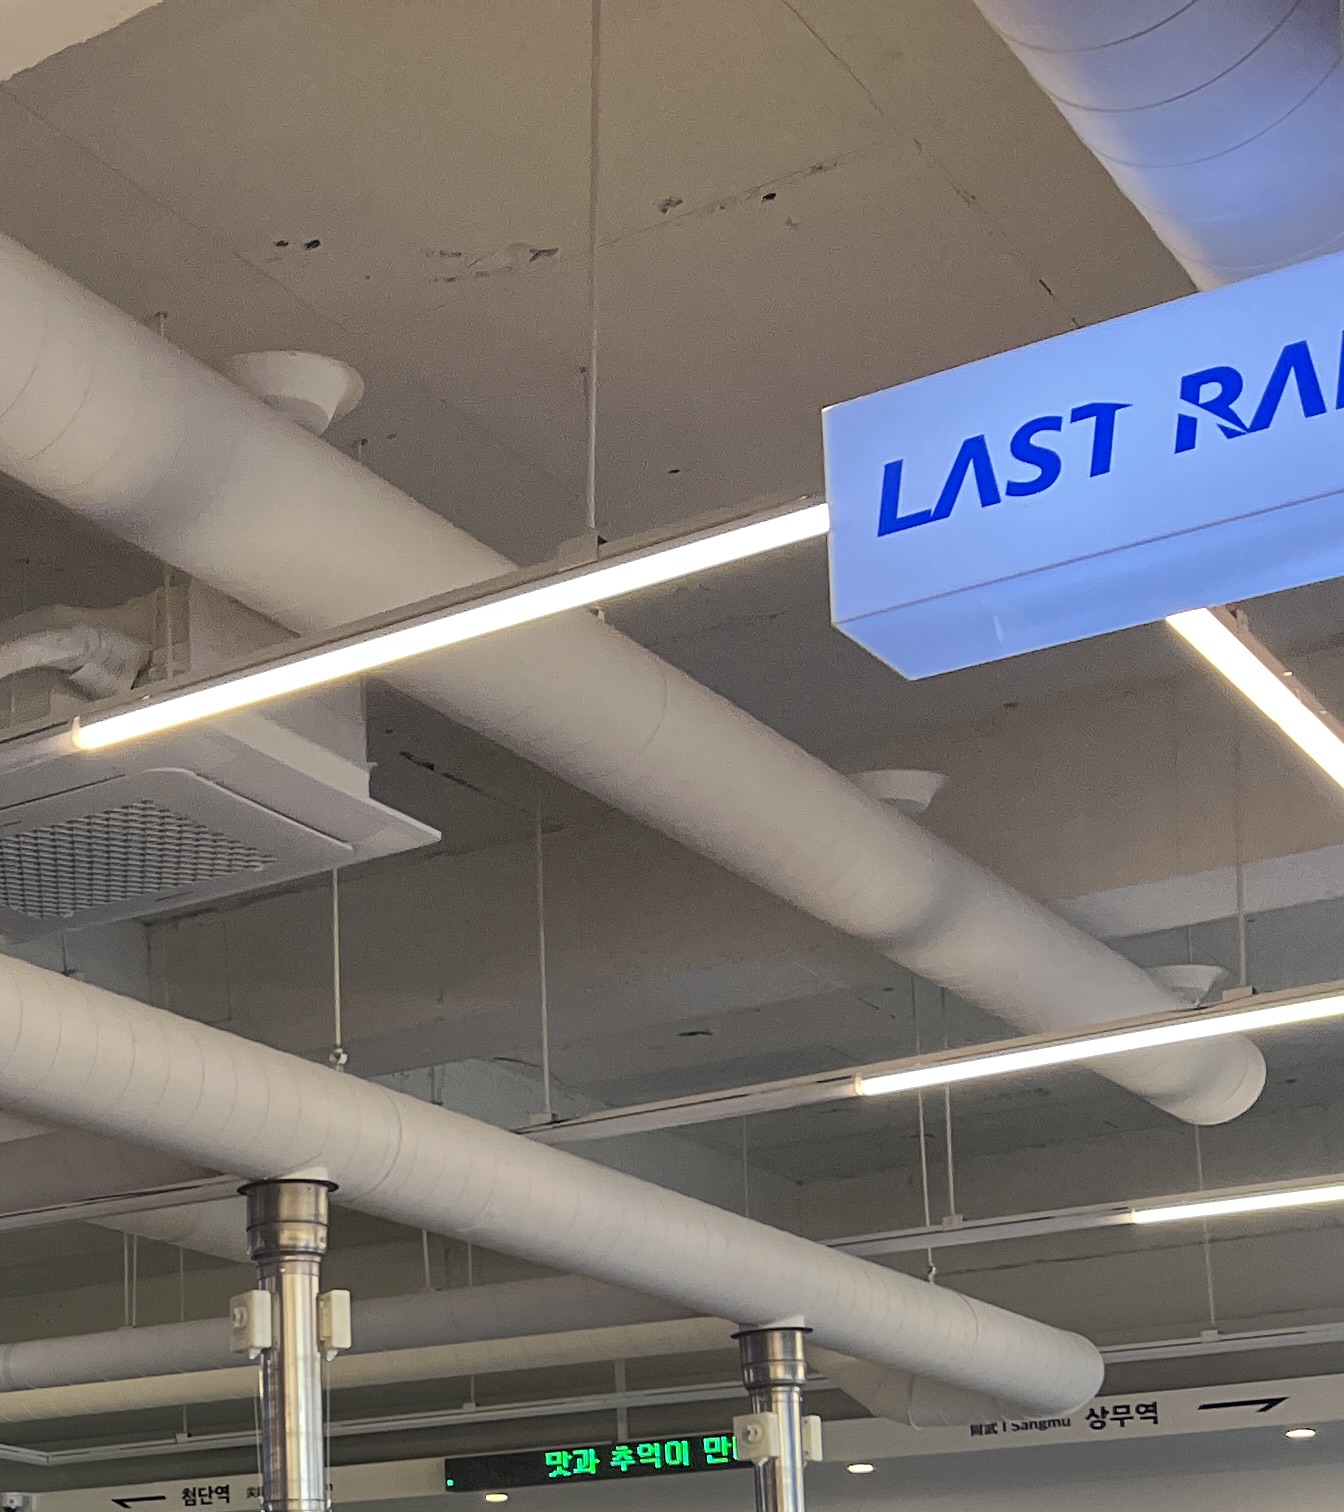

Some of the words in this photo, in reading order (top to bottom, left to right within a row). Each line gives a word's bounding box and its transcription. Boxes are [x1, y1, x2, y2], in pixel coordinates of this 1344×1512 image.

[877, 401, 1134, 538] LAST
[1011, 1416, 1072, 1433] Sangmu
[1085, 1401, 1159, 1431] 상무역
[544, 1448, 601, 1478] 맛과
[610, 1440, 691, 1472] 추억이
[181, 1484, 231, 1507] 첨단역
